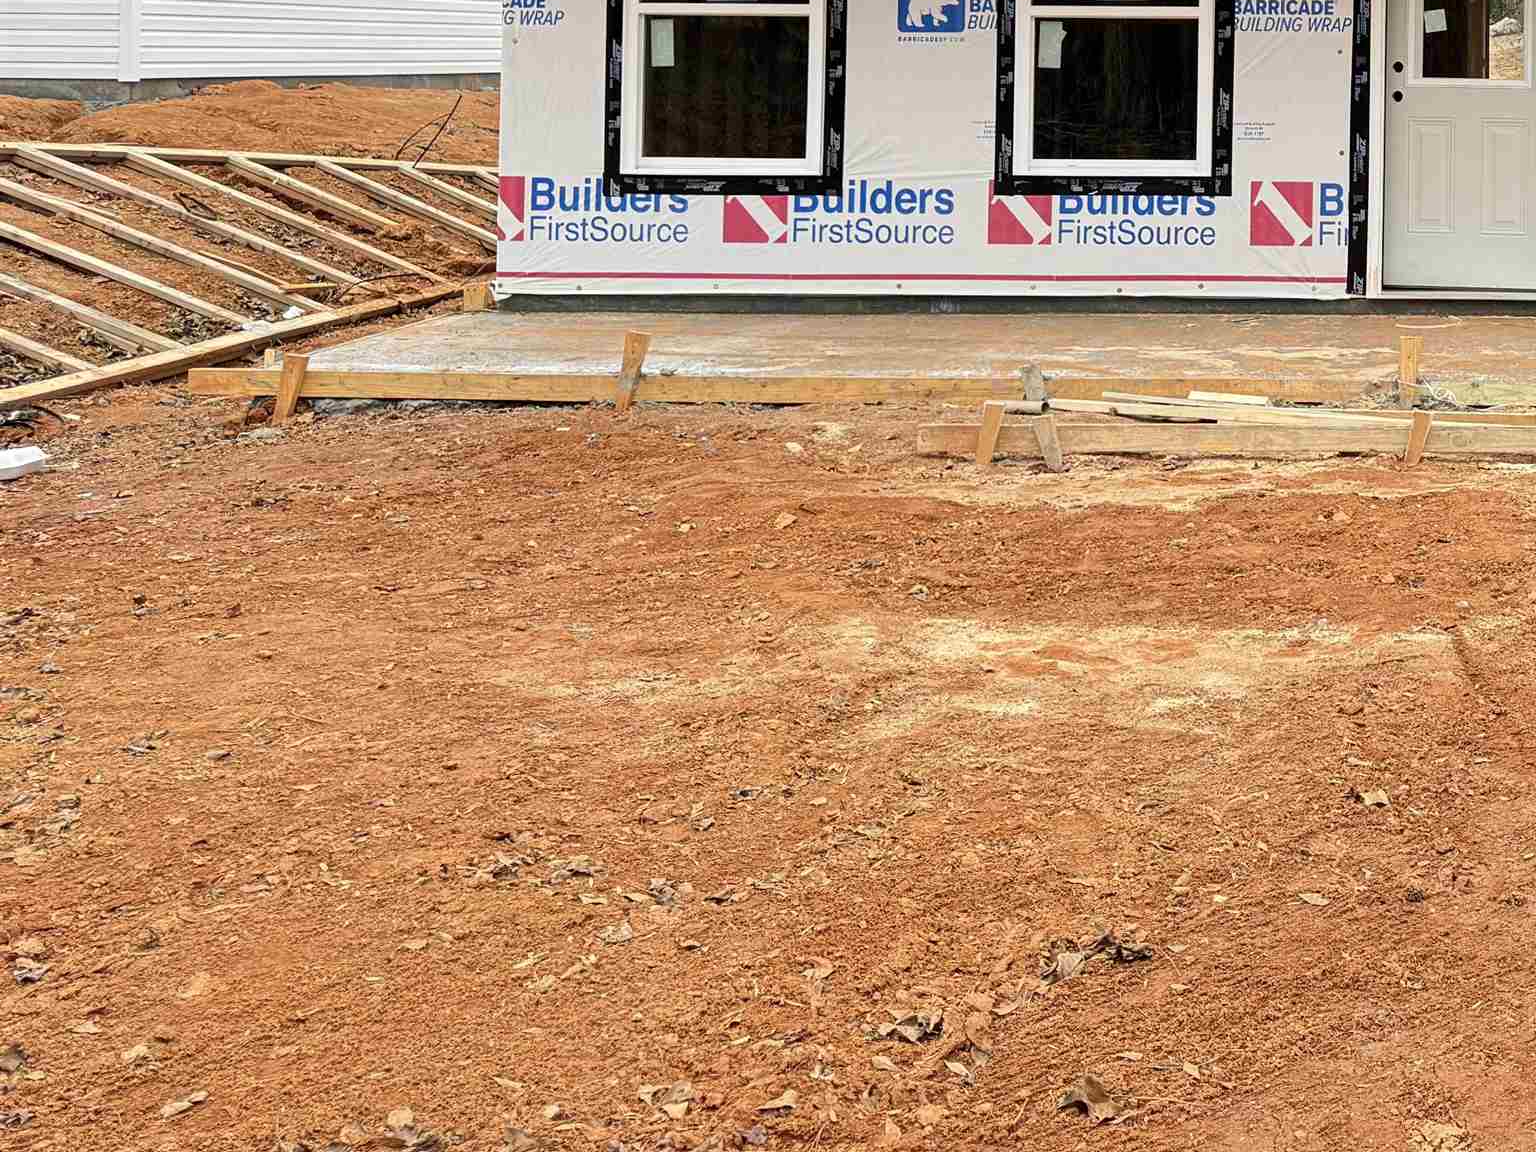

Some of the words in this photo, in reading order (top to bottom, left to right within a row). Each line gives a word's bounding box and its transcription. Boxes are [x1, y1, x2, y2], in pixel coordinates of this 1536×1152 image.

[1235, 0, 1334, 14] BARRICADE
[520, 10, 565, 25] WRAP
[1308, 17, 1352, 32] WRAP
[530, 216, 688, 242] FirstSource
[793, 218, 954, 244] FirstSource
[1058, 219, 1215, 245] FirstSource
